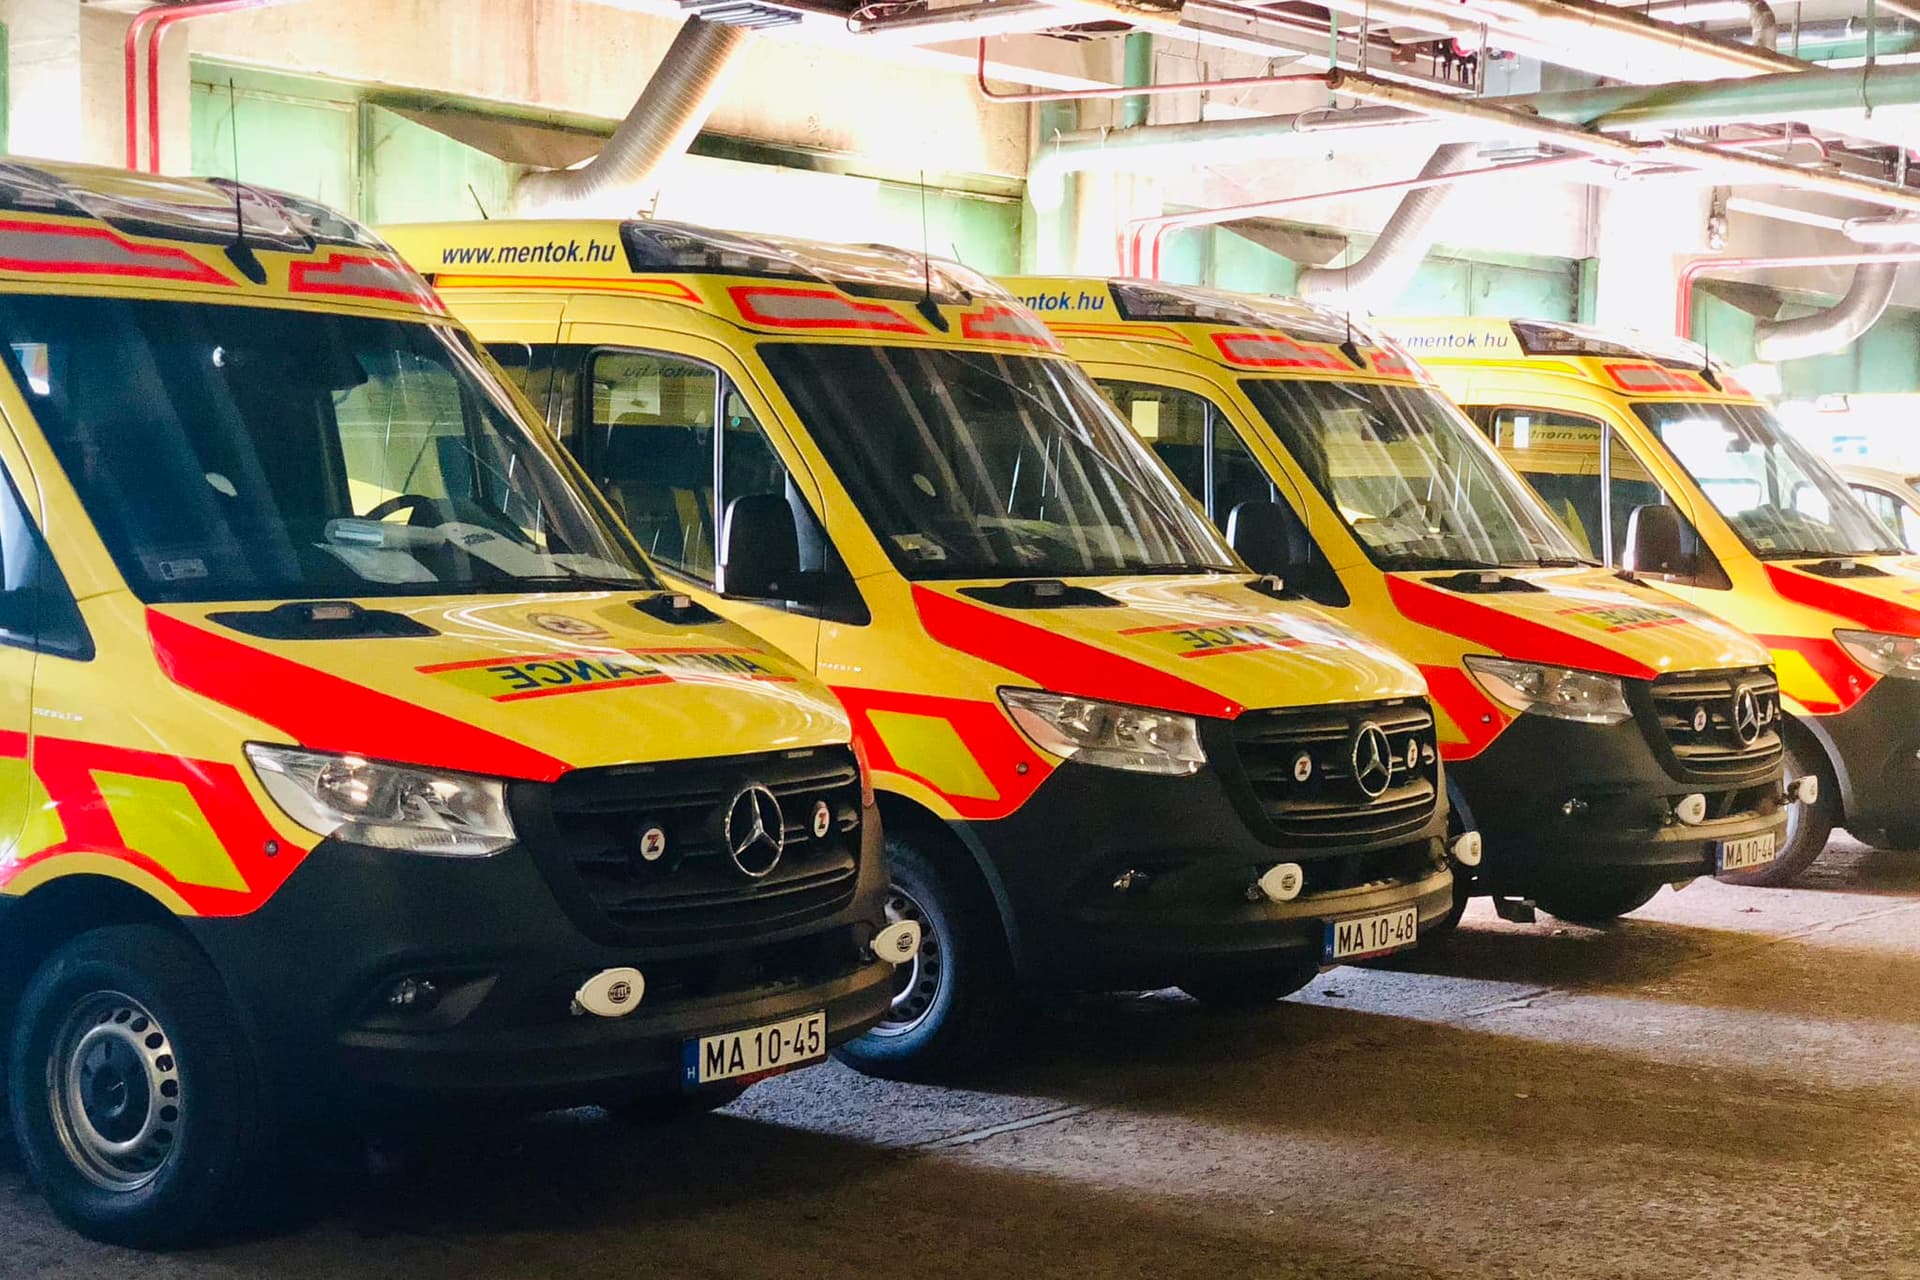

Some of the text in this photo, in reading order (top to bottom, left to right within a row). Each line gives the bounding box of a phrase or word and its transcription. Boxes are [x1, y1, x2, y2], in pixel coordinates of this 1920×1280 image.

[442, 239, 616, 265] www.mentok.hu
[1726, 843, 1743, 867] MA
[1746, 838, 1773, 864] 10-44
[1325, 912, 1414, 955] H MA 10-48
[687, 1018, 820, 1080] H MA 10-45
